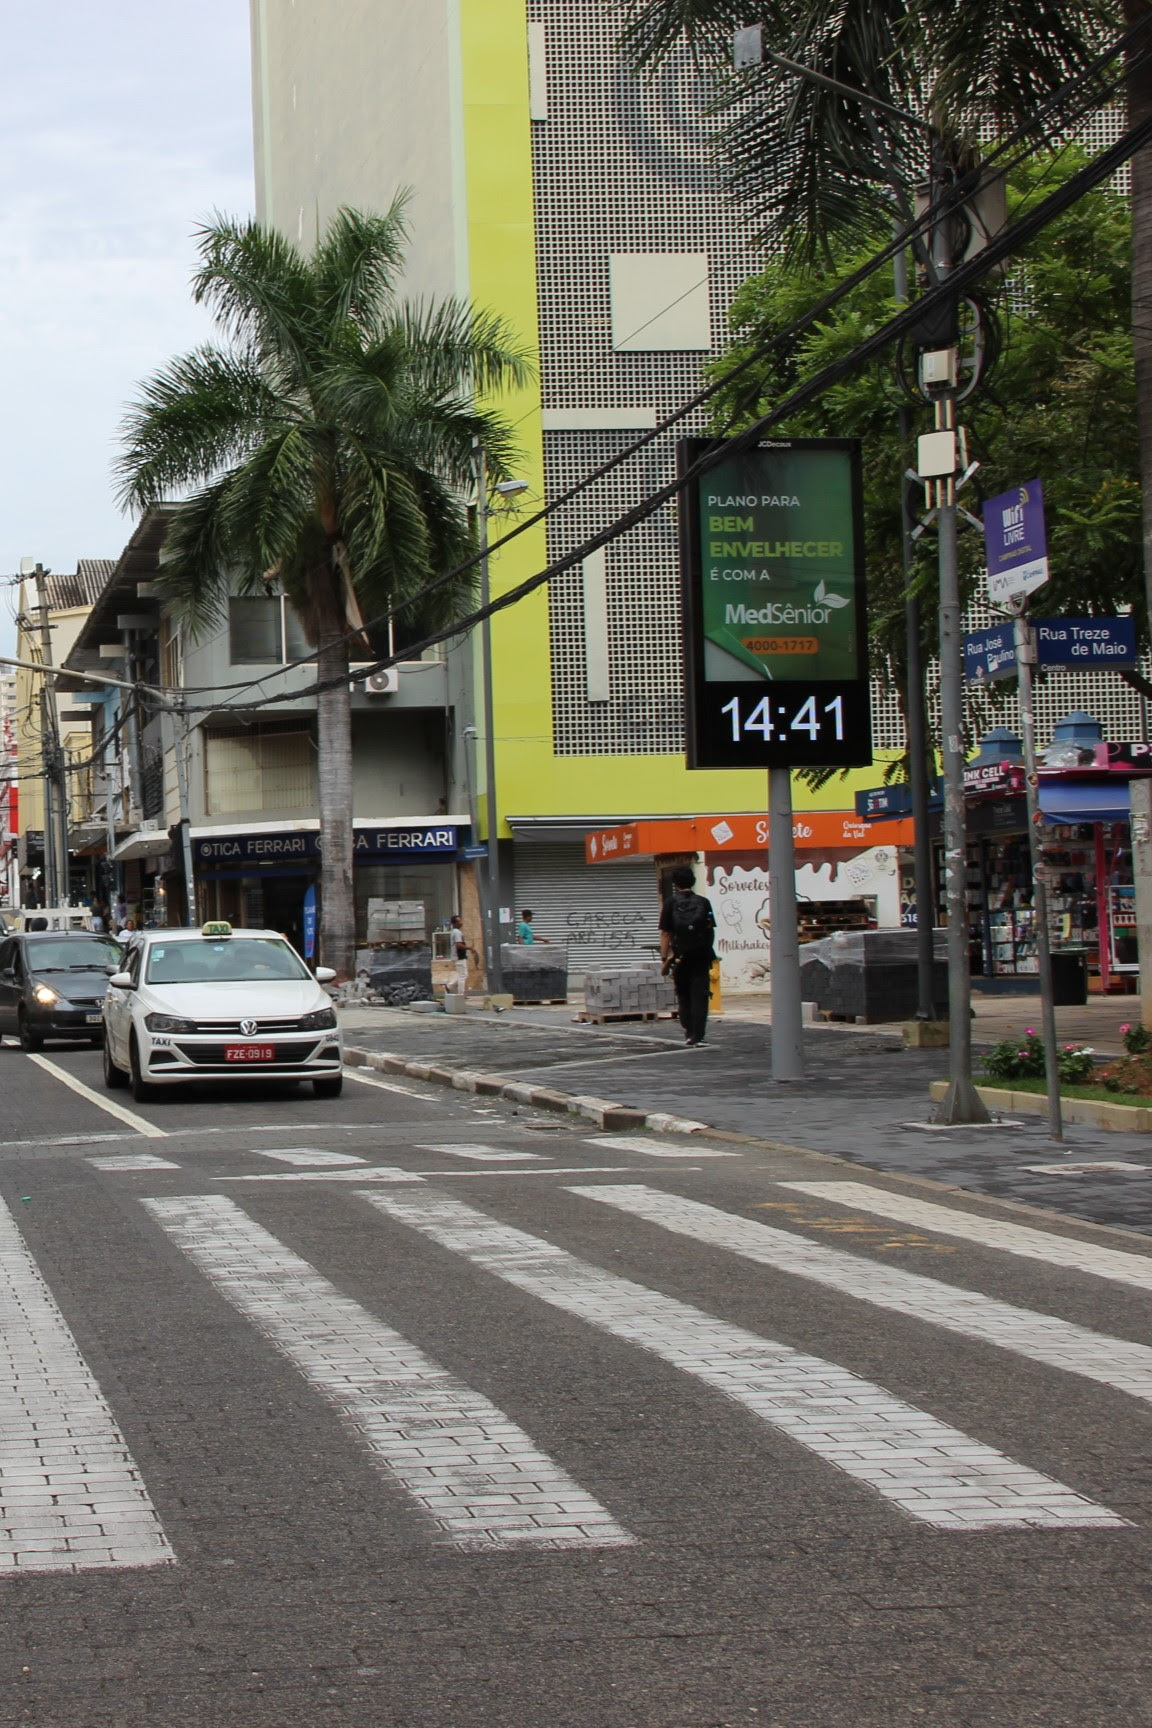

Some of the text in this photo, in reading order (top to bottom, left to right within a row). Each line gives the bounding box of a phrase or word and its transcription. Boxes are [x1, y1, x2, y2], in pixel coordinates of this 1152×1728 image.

[758, 440, 792, 448] JCDecaux
[707, 495, 800, 507] PLANO PARA
[709, 516, 754, 532] BEM
[1003, 527, 1025, 546] LIVRE
[709, 541, 844, 558] ENVELHECER
[710, 567, 770, 581] É COM A
[724, 602, 832, 625] MedSênior
[1039, 627, 1110, 640] Rua Treze
[746, 640, 814, 651] 4000-1717
[967, 634, 1002, 656] Rua José
[1071, 642, 1127, 656] de Maio
[1040, 663, 1066, 672] Centro
[720, 695, 844, 742] 14:41
[981, 766, 1005, 778] CELL
[247, 839, 305, 854] FERRARI
[377, 831, 453, 848] FERRARI
[719, 876, 770, 895] Sorvetes
[207, 924, 231, 934] TAXI
[718, 937, 770, 955] Milkshakes
[151, 1037, 172, 1047] TAXI
[227, 1049, 272, 1059] FZE-0919
